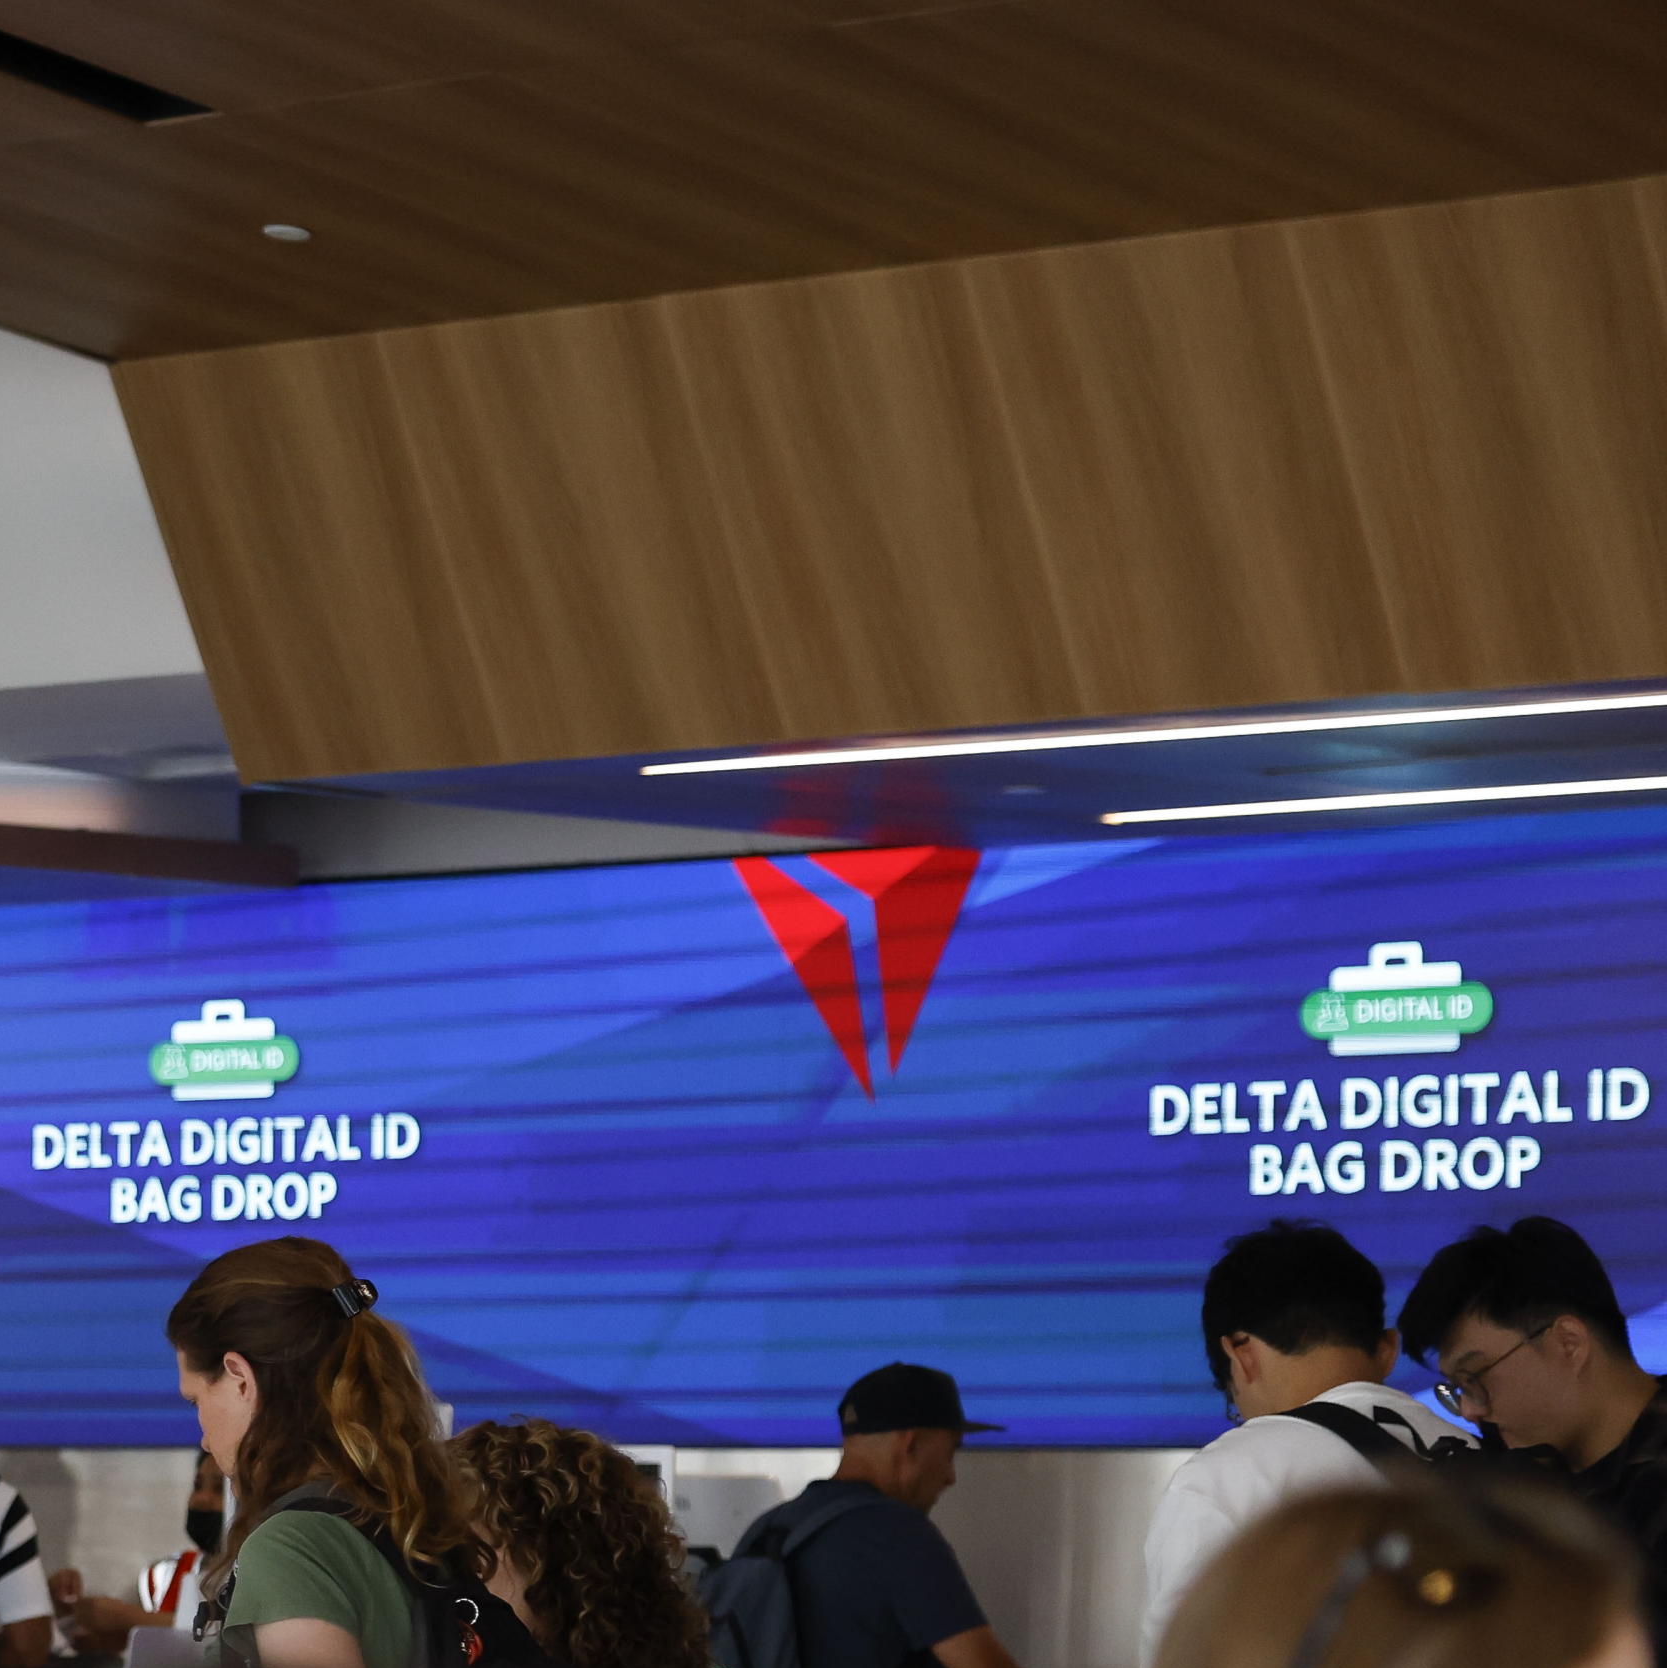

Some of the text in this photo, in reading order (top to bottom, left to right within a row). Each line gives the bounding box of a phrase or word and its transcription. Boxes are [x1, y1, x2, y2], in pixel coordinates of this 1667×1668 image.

[1353, 994, 1473, 1023] DIGITAL ID
[190, 1046, 285, 1072] DIGITAL ID
[1148, 1066, 1651, 1136] DELTA DIGITAL ID
[31, 1112, 421, 1171] DELTA DIGITAL ID
[1248, 1136, 1541, 1196] BAG DROP
[109, 1171, 337, 1224] BAG DROP
